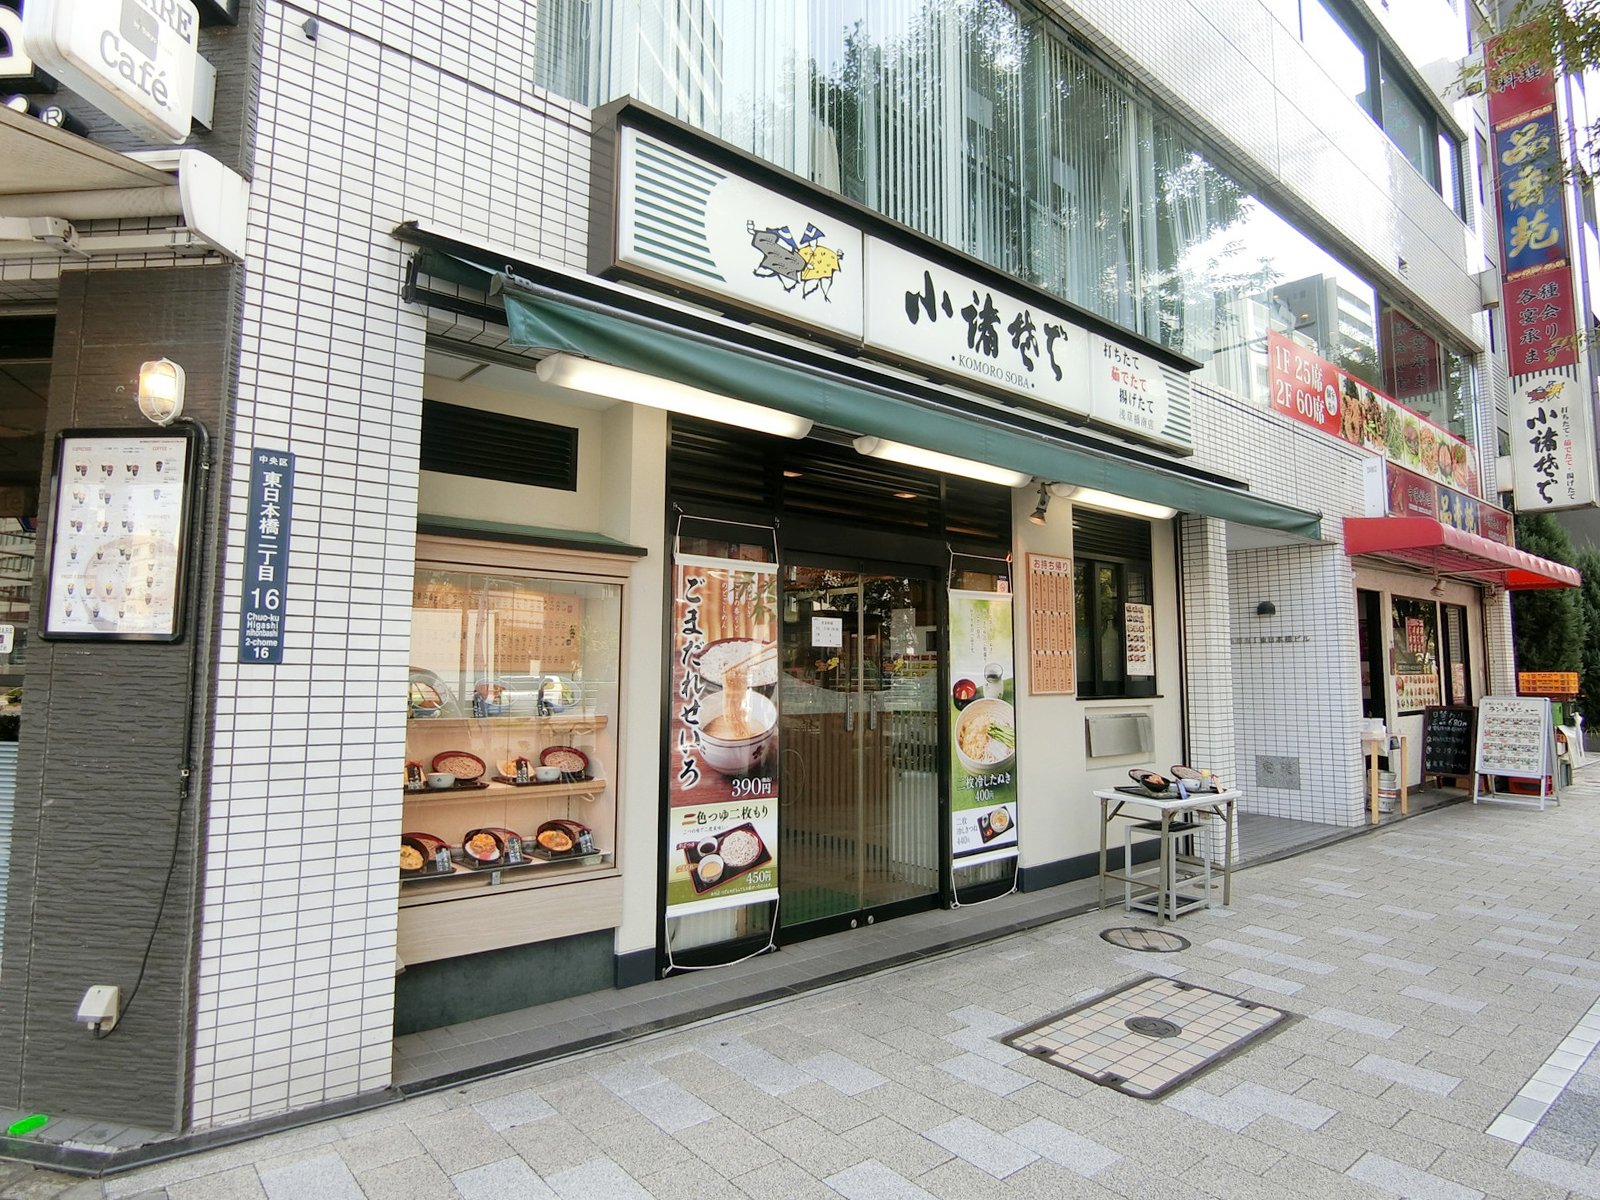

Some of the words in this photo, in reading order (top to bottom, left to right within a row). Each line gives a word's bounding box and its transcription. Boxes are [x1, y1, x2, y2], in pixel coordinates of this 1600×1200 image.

[1103, 342, 1140, 370] 打ちたて
[958, 354, 1004, 380] KOMORO
[1005, 372, 1030, 389] SOBA
[1111, 366, 1147, 392] 茹でたて
[1275, 345, 1291, 374] 1F
[1294, 356, 1323, 393] 25席
[1119, 388, 1154, 414] 揚げたて
[1276, 378, 1293, 408] 2F
[1296, 389, 1325, 425] 60席
[259, 455, 288, 467] 中央区
[257, 471, 282, 581] 東日本橋二丁目
[1034, 559, 1068, 571] お持ち帰り
[251, 587, 280, 610] 16
[246, 612, 280, 622] Chuo-ku
[246, 620, 279, 631] Higashi
[245, 628, 279, 638] nihonbashi
[245, 638, 278, 647] 2-chome
[253, 646, 270, 659] 16
[680, 577, 705, 788] ごまだれせいろ
[731, 777, 772, 797] 390円
[958, 771, 1011, 791] 二枚冷したぬき
[682, 805, 768, 826] 二色つゆ二枚もり
